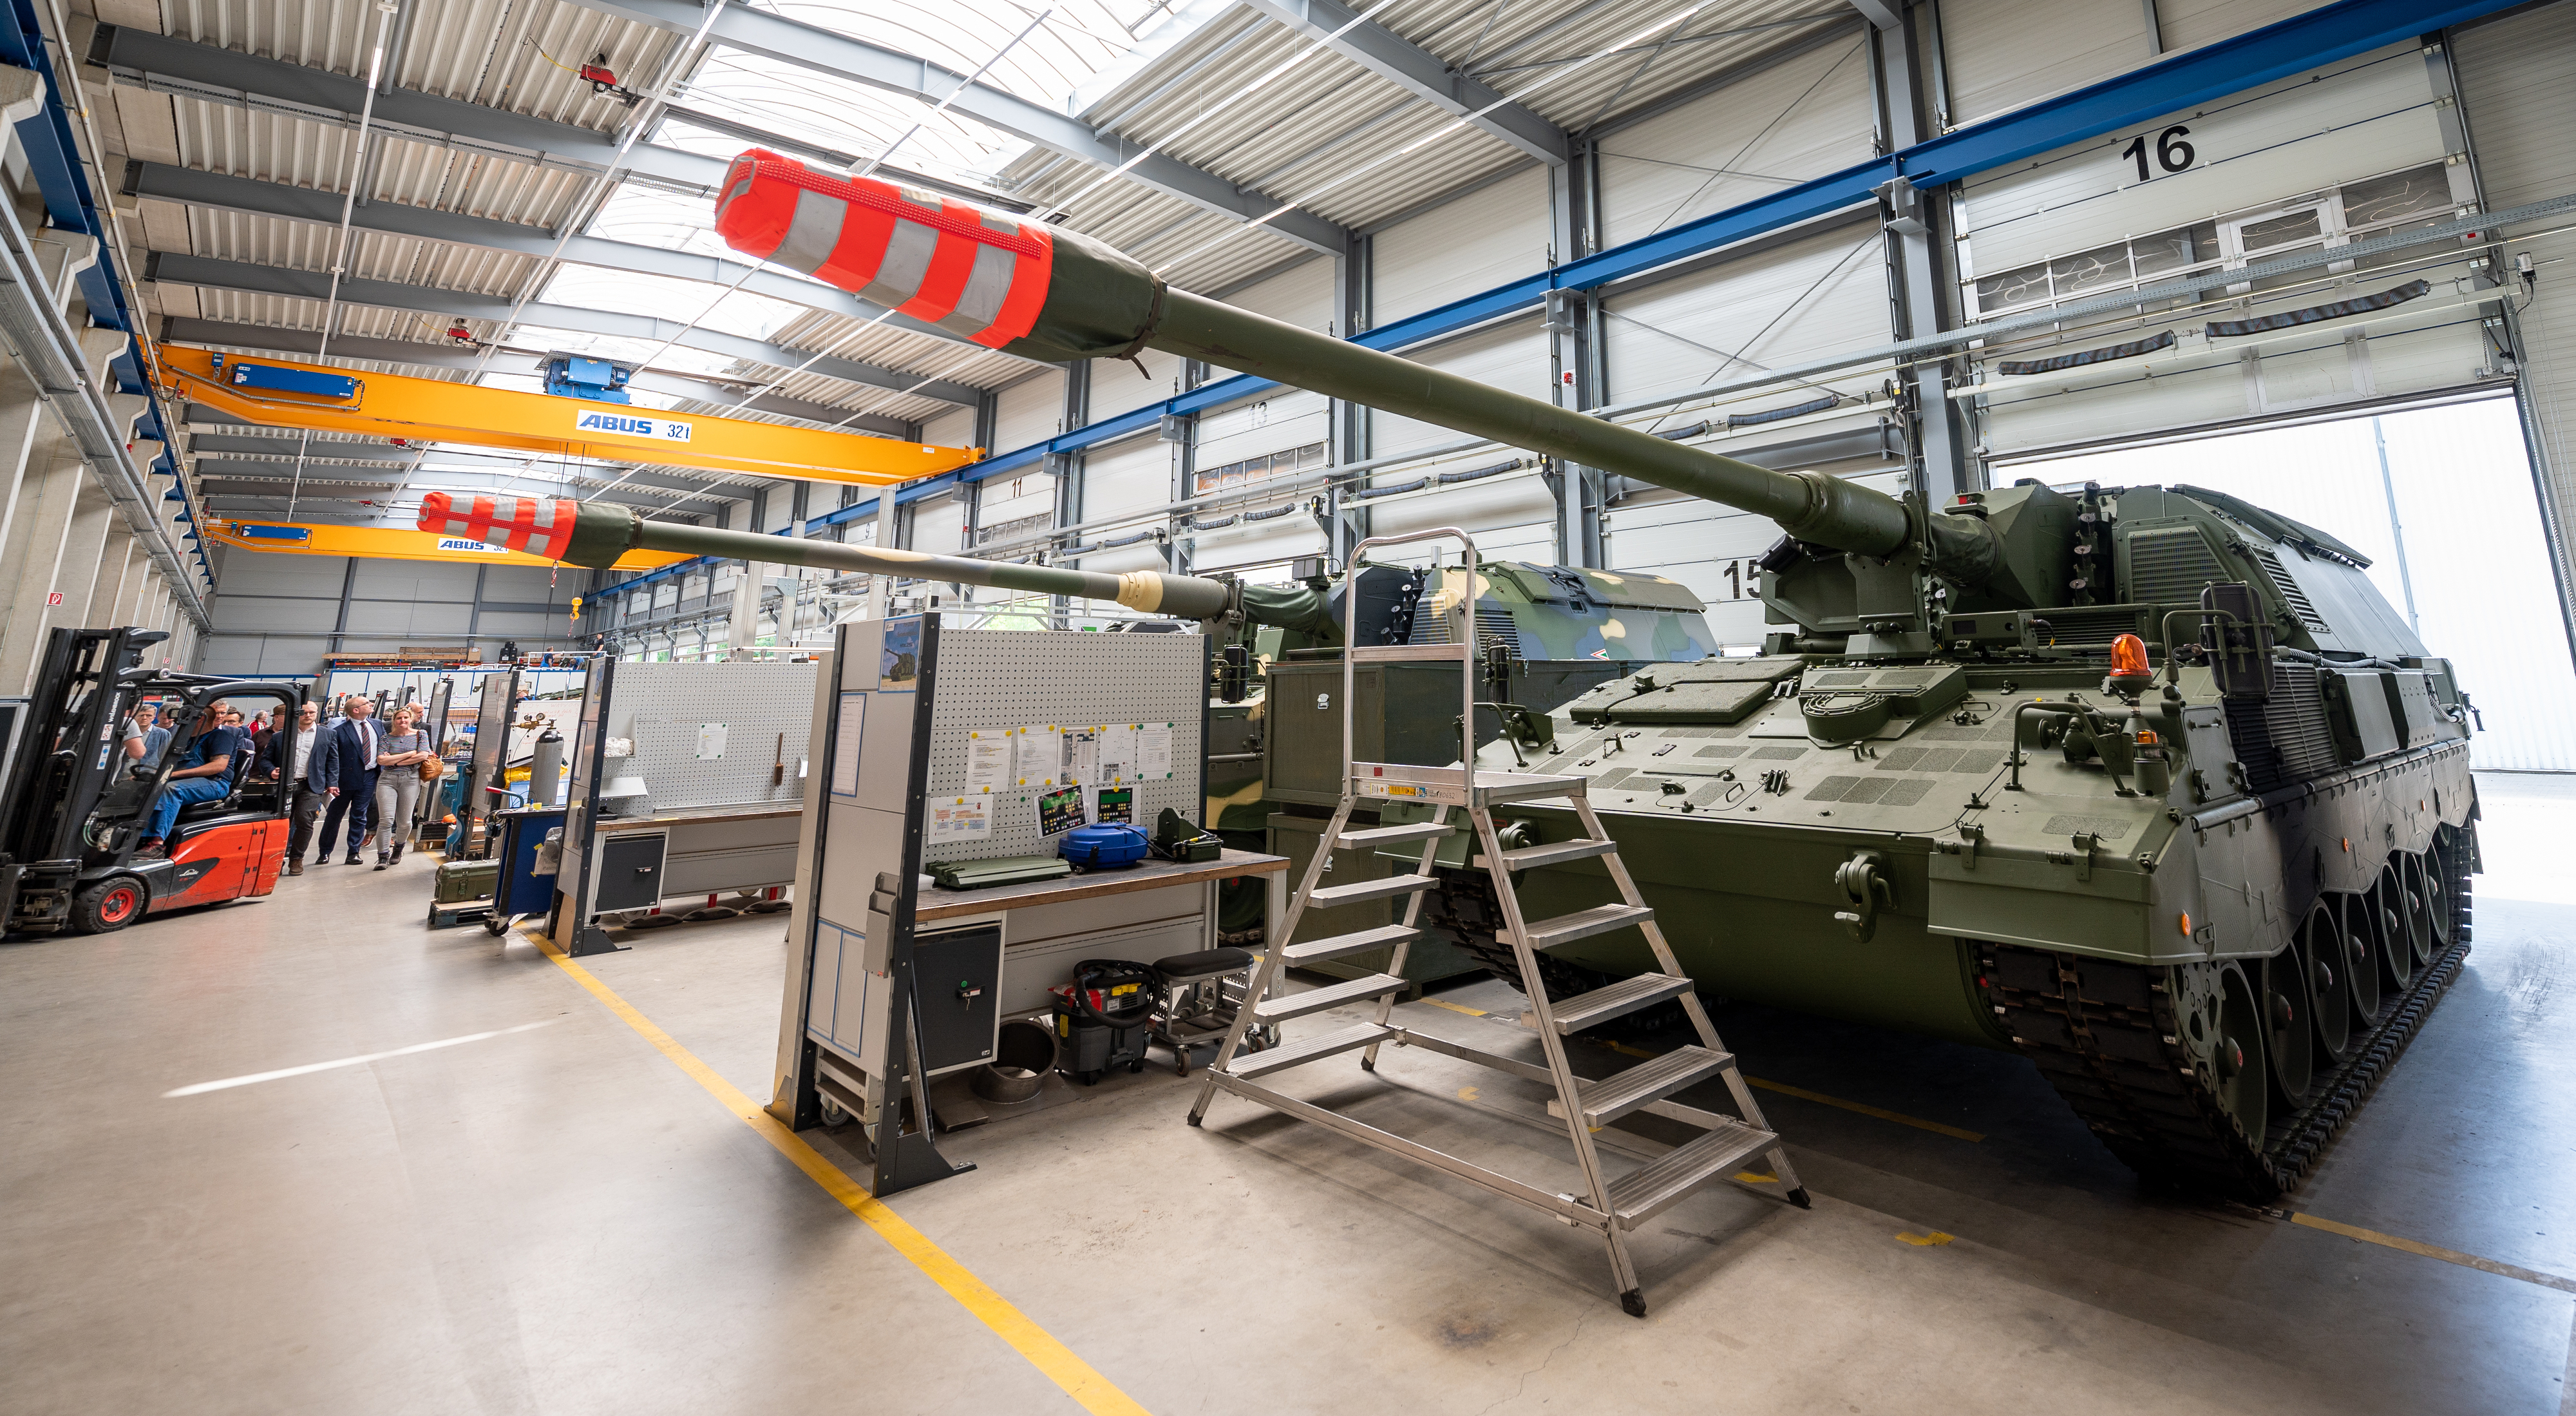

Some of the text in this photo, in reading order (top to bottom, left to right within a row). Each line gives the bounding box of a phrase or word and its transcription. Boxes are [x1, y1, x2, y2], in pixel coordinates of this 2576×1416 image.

[2123, 125, 2195, 182] 16
[580, 414, 652, 434] ABUS
[1248, 401, 1267, 430] 13
[1012, 477, 1022, 498] 11
[440, 540, 484, 550] ABUS
[1723, 559, 1761, 599] 15
